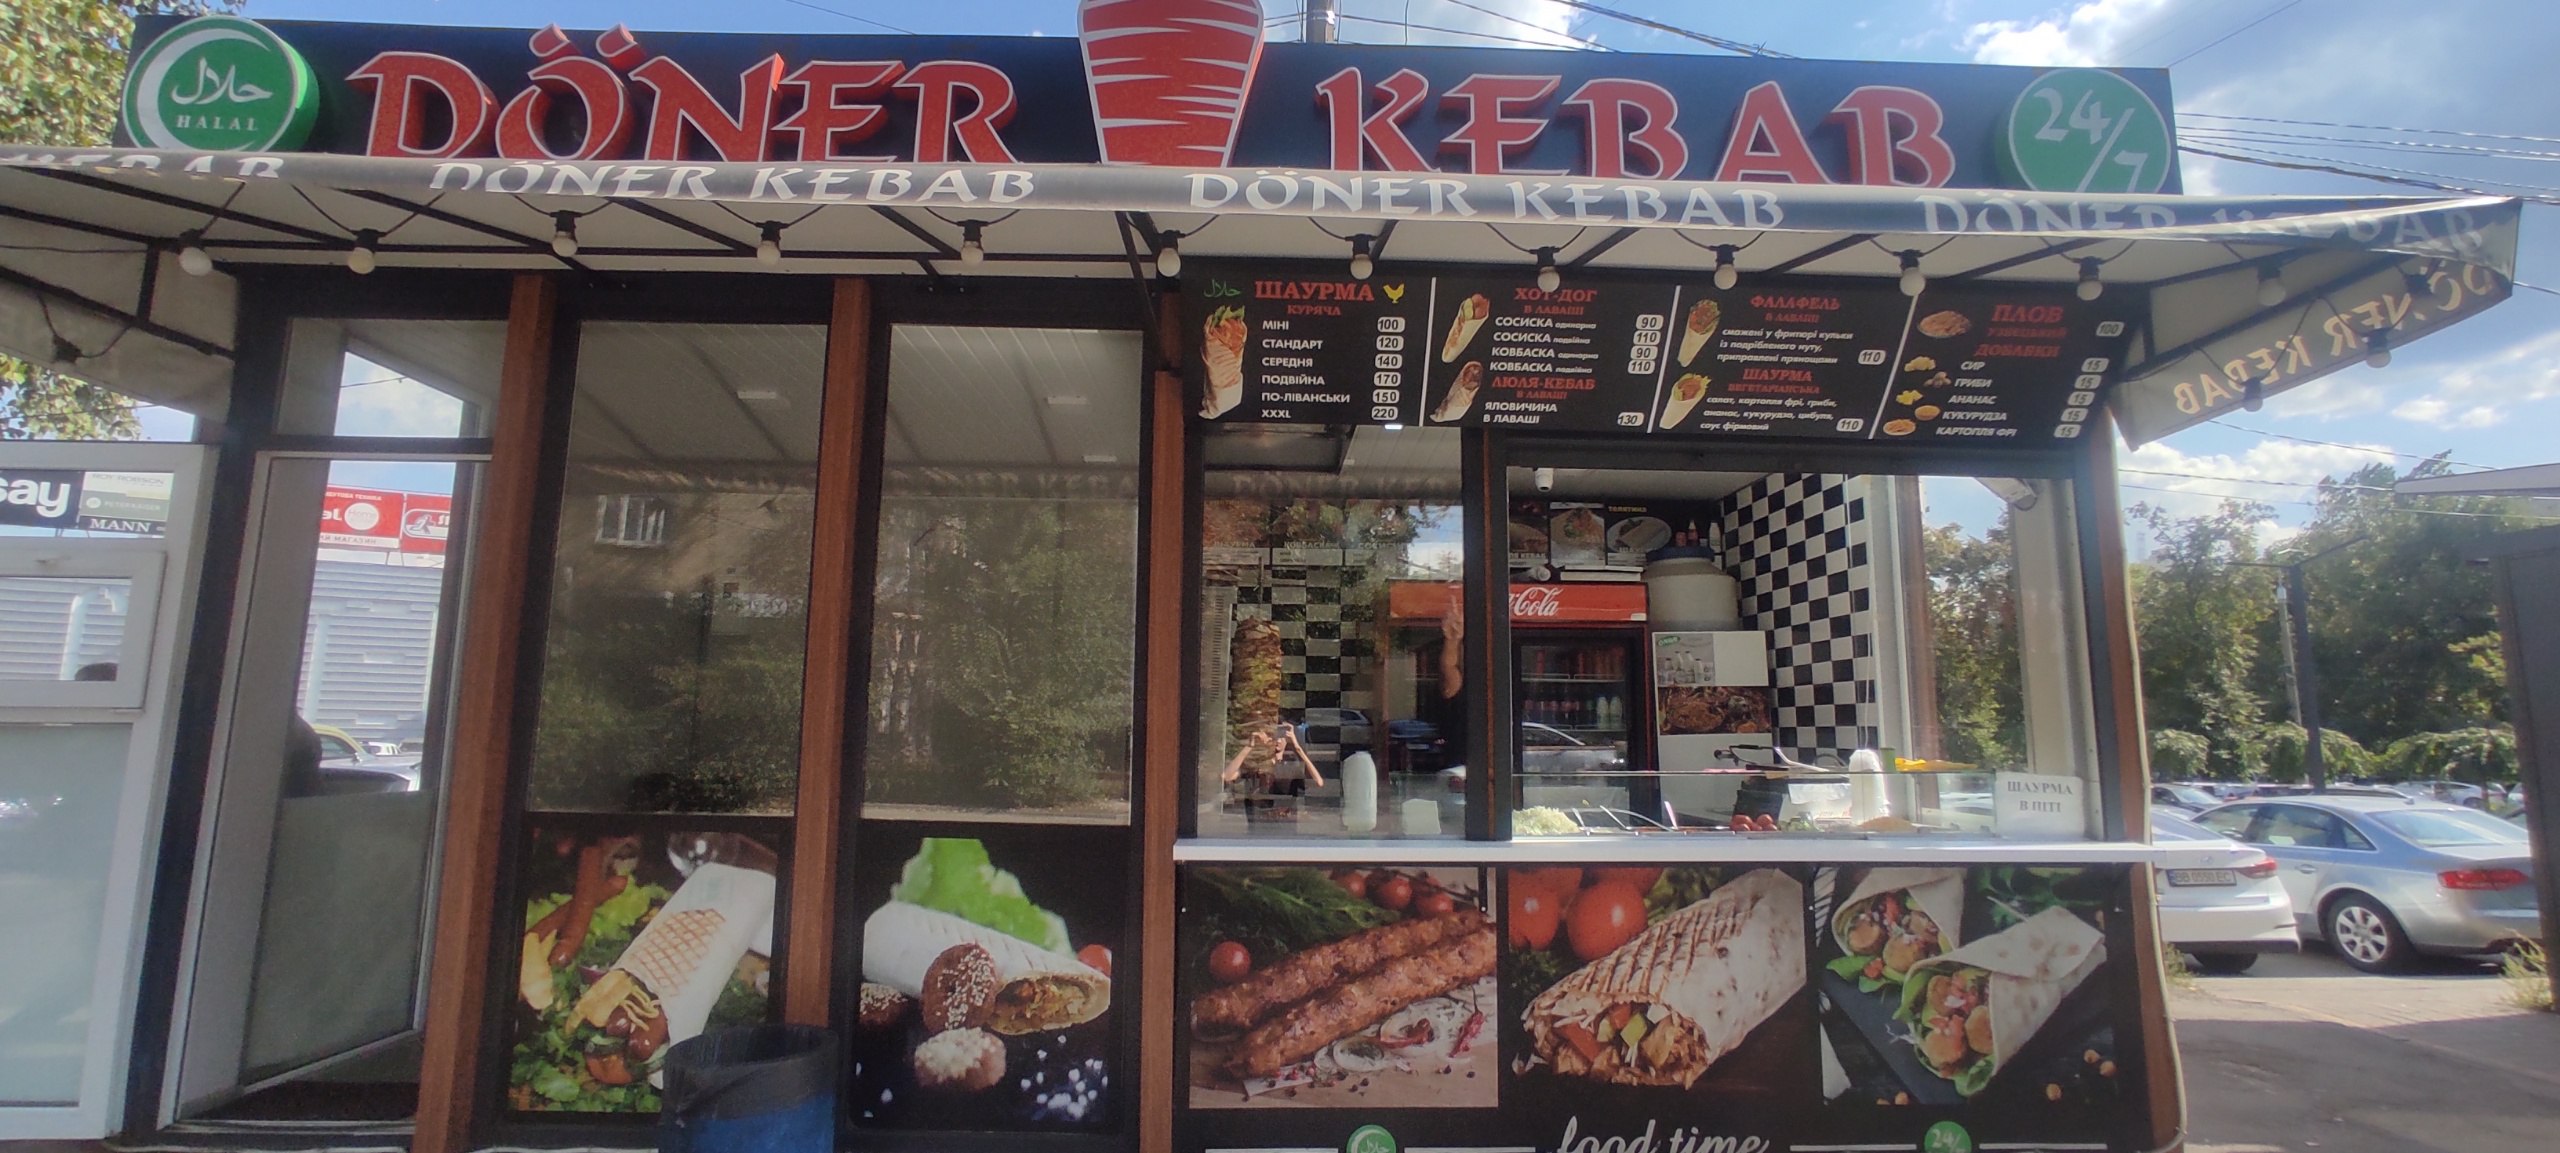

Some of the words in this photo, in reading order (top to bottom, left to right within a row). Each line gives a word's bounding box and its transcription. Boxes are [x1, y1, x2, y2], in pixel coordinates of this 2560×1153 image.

[171, 57, 274, 105] حلال
[345, 23, 1020, 163] DÖNER
[1316, 66, 1956, 188] KEBAB
[176, 115, 258, 131] HALAL
[2034, 87, 2149, 193] 24/7
[429, 160, 713, 201] DÖNER
[749, 168, 1036, 204] KEBAB
[1184, 170, 1478, 216] DÖNER
[1504, 180, 1785, 230] KEBAB
[1254, 280, 1375, 302] ШАУРМА
[1514, 288, 1598, 303] ХОТ-ДОГ
[1751, 295, 1841, 310] ФАЛАФЕЛЬ
[1287, 304, 1342, 316] КУРЯЧА
[1992, 304, 2064, 323] ПЛОВ
[1262, 320, 1289, 330] МІНІ
[1378, 320, 1399, 330] 100
[1495, 317, 1553, 328] СОСИСКА
[1641, 317, 1657, 328] 90
[2100, 324, 2119, 334] 100
[1493, 332, 1552, 342] СОСИСКА
[1636, 332, 1657, 343] 110
[1262, 339, 1323, 350] СТАНДАРТ
[1379, 338, 1399, 348] 120
[1492, 348, 1554, 358] КОВБАСКА
[1636, 348, 1650, 358] 90
[1862, 352, 1880, 362] 110
[1262, 357, 1313, 368] СЕРЕДНЯ
[1377, 356, 1398, 367] 140
[1490, 362, 1552, 372] КОВБАСКА
[1630, 362, 1650, 372] 110
[1960, 361, 1986, 371] СИР
[2087, 360, 2100, 370] 15
[1262, 374, 1325, 386] ПОДВІЙНА
[1376, 374, 1398, 384] 170
[1742, 368, 1812, 382] ШАУРМА
[1492, 376, 1596, 390] ЛЮЛЯ-КЕБАБ
[1954, 378, 1992, 388] ГРИБИ
[2080, 378, 2093, 388] 15
[1262, 392, 1350, 403] ПО-ЛІВАНСЬКИ
[1374, 392, 1397, 402] 150
[1948, 395, 1998, 404] АНАНАС
[2074, 394, 2088, 404] 15
[1261, 409, 1291, 418] XXXL
[1373, 408, 1395, 418] 220
[1485, 402, 1558, 412] ЯЛОВИЧИНА
[1483, 414, 1490, 423] В
[1493, 415, 1540, 424] ЛАВАШІ
[1618, 414, 1638, 425] 130
[2067, 410, 2080, 421] 15
[1839, 420, 1859, 430] 110
[2060, 426, 2074, 437] 15
[90, 518, 150, 532] MANN
[2007, 780, 2073, 795] ШАУРМА
[2020, 801, 2028, 812] В
[2032, 802, 2062, 813] ПІТІ
[1557, 1116, 1659, 1153] food
[1670, 1127, 1770, 1153] time
